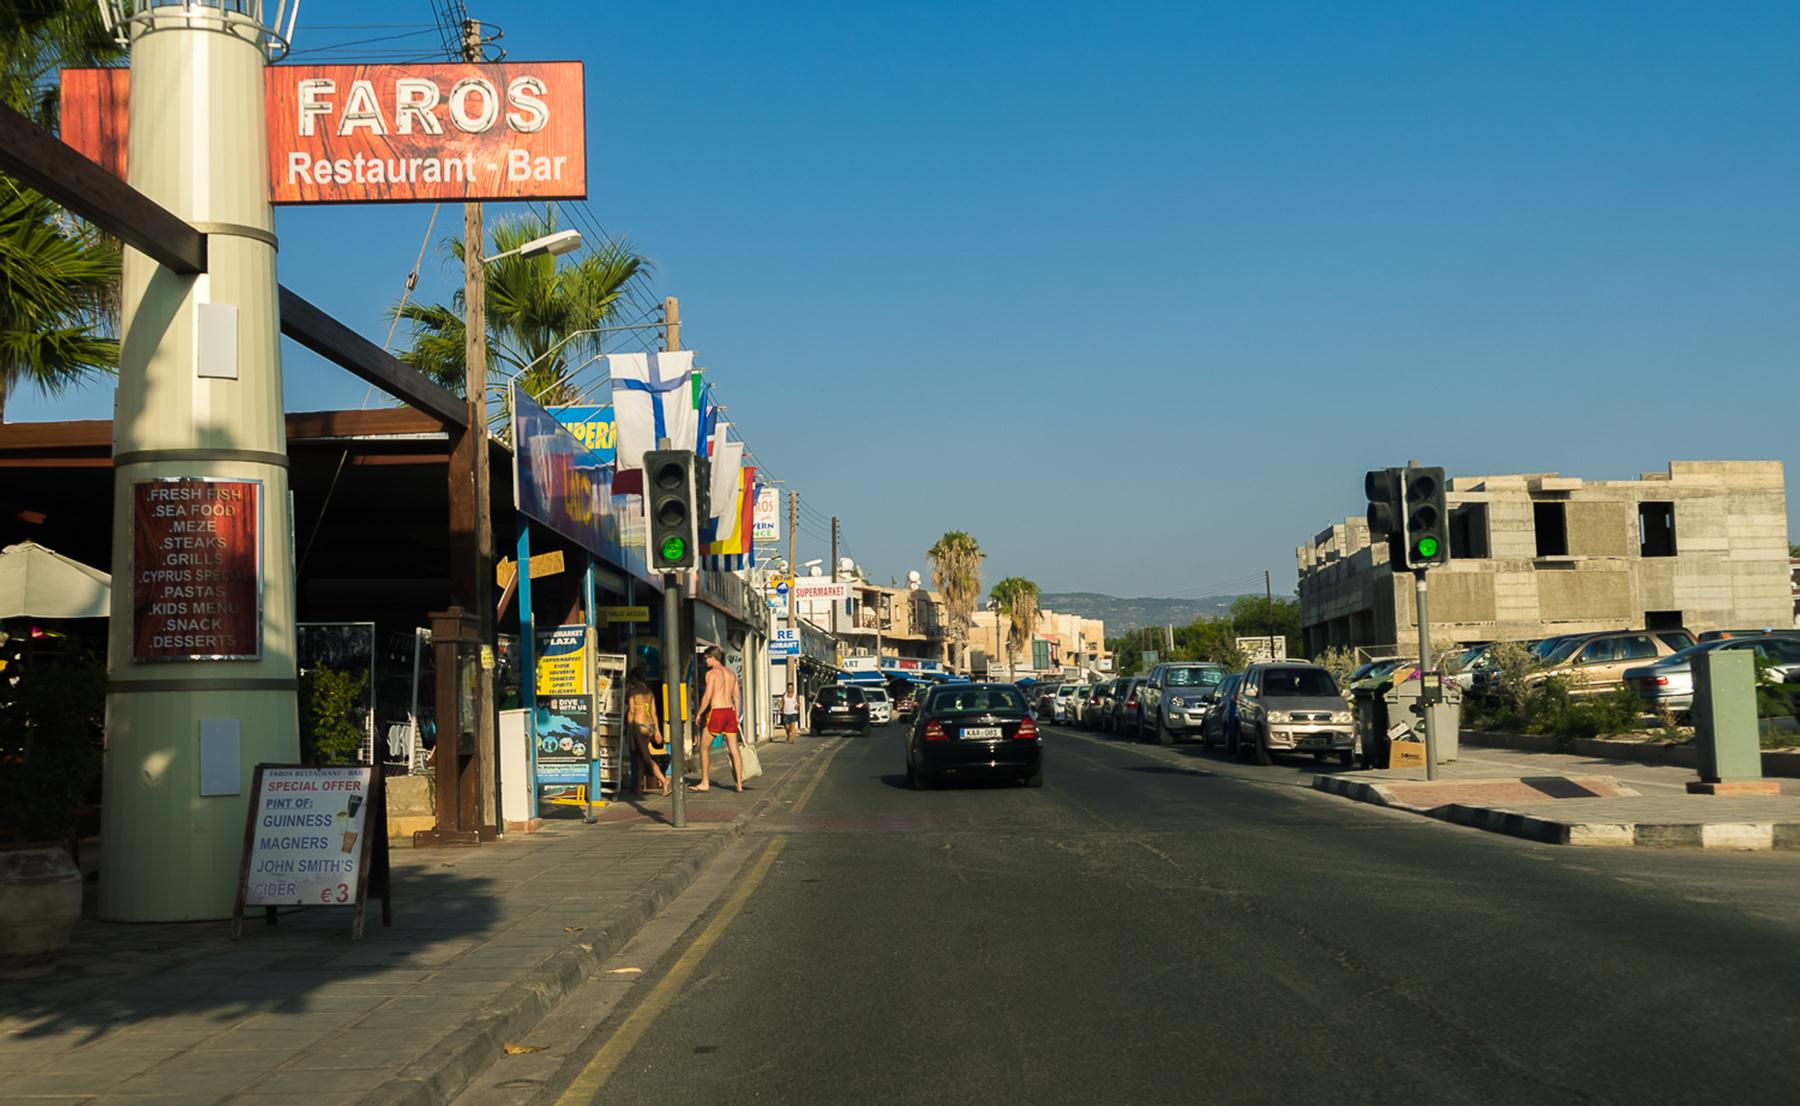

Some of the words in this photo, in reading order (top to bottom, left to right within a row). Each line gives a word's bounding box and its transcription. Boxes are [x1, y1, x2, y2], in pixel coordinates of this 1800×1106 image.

[298, 76, 550, 137] FAROS
[288, 151, 476, 185] Restaurant
[508, 149, 566, 182] Bar
[206, 488, 242, 501] FISH
[191, 505, 235, 516] FOOD
[796, 586, 843, 598] SUPERMARKET
[193, 602, 238, 614] MENU
[268, 781, 318, 792] SPECIAL
[322, 781, 361, 791] OFFER
[266, 798, 291, 808] PINT
[295, 798, 314, 808] OF:
[263, 815, 333, 828] GUINNESS
[260, 837, 329, 850] MAGNERS
[256, 860, 295, 873] JOHN
[298, 859, 354, 873] SMITH'S
[254, 883, 296, 896] CIDER
